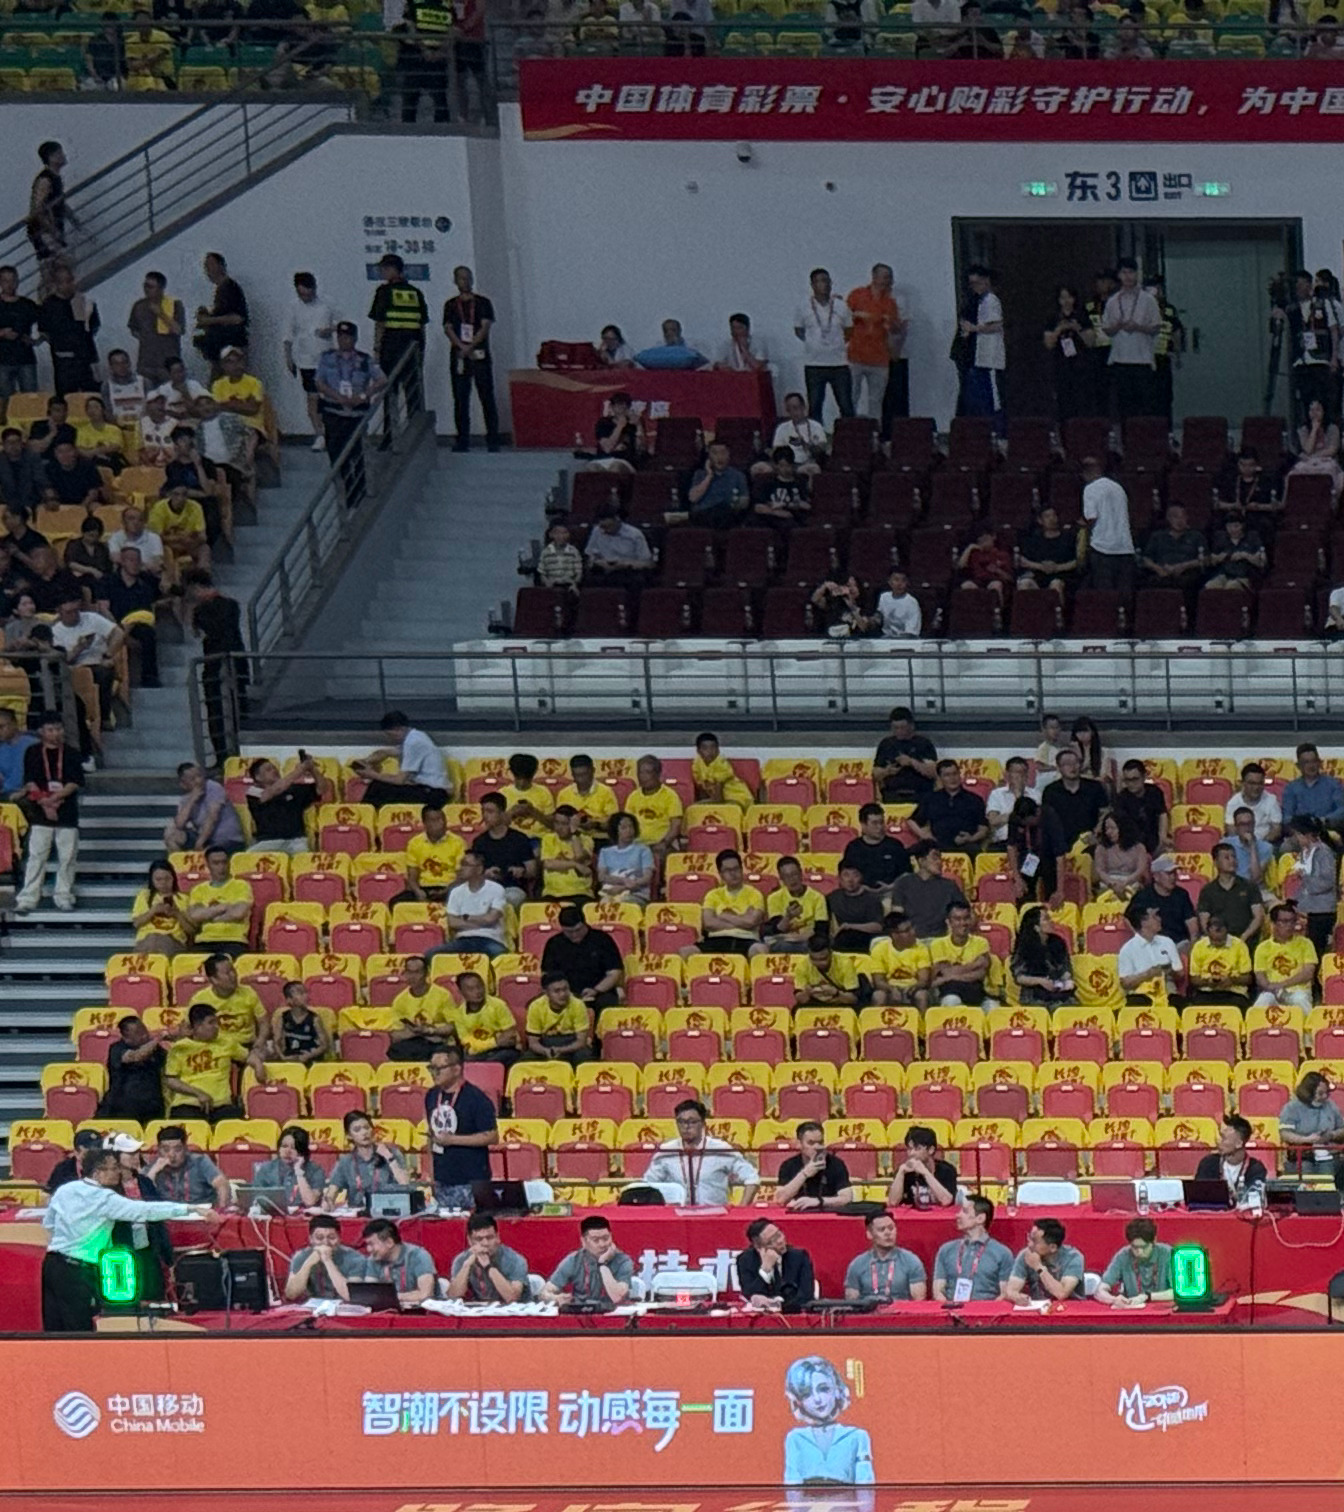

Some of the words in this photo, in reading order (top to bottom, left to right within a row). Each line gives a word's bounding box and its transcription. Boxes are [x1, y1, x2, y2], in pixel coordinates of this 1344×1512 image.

[1064, 170, 1121, 202] 东3
[1163, 172, 1192, 189] 出口
[107, 1393, 204, 1416] 中国移动
[110, 1418, 153, 1433] China
[156, 1418, 205, 1433] Mobile
[362, 1390, 549, 1436] 智潮不设限
[558, 1389, 756, 1452] 动感每一面
